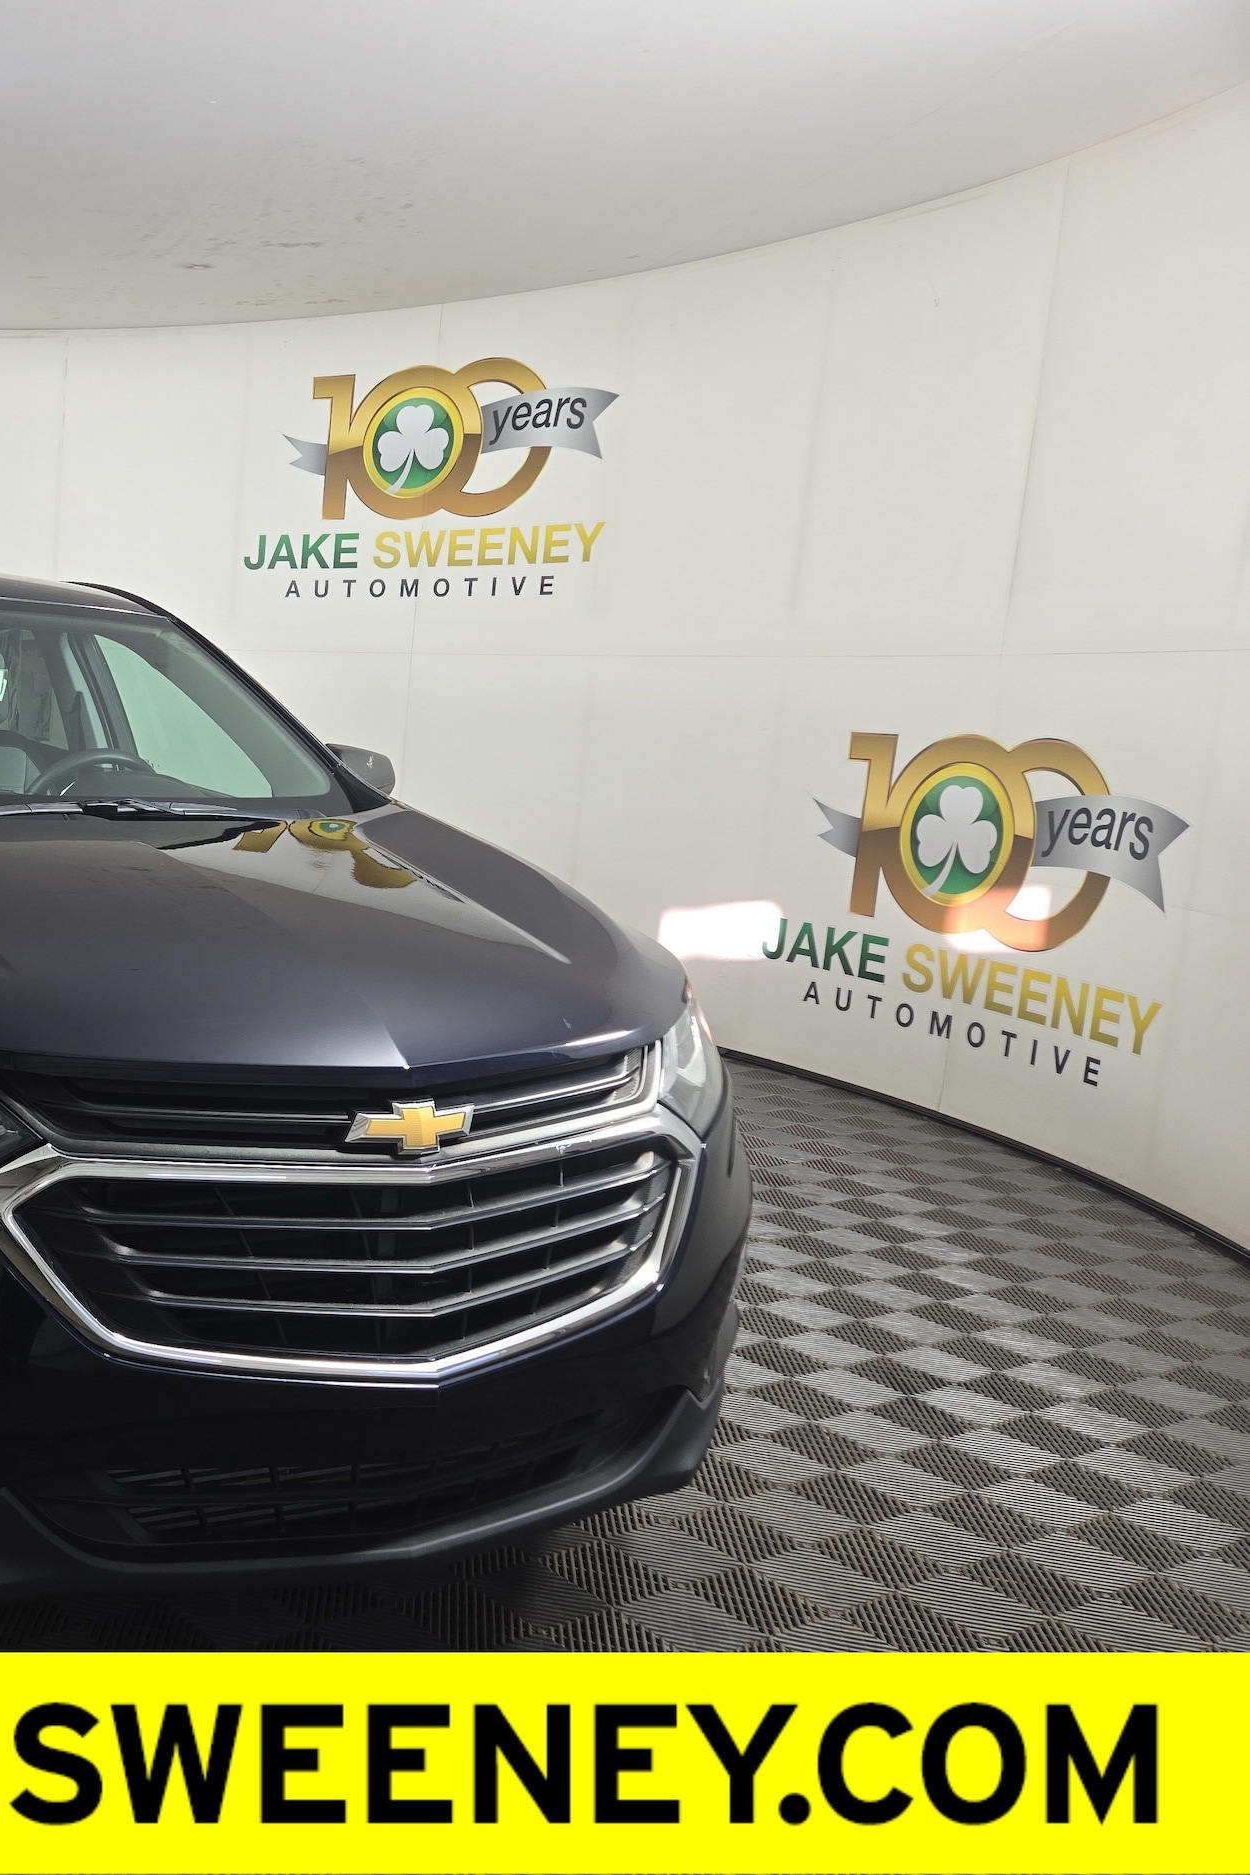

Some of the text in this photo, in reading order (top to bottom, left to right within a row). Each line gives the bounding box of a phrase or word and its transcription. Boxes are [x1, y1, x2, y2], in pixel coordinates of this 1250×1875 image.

[313, 357, 552, 520] 100
[489, 397, 587, 445] years
[243, 521, 606, 570] JAKE SWEENEY
[285, 576, 554, 598] AUTOMOTIVE
[849, 732, 1111, 952] 100
[1041, 807, 1154, 861] years
[762, 918, 1162, 1055] JAKE SWEENEY
[803, 981, 1101, 1087] AUTOMOTIVE
